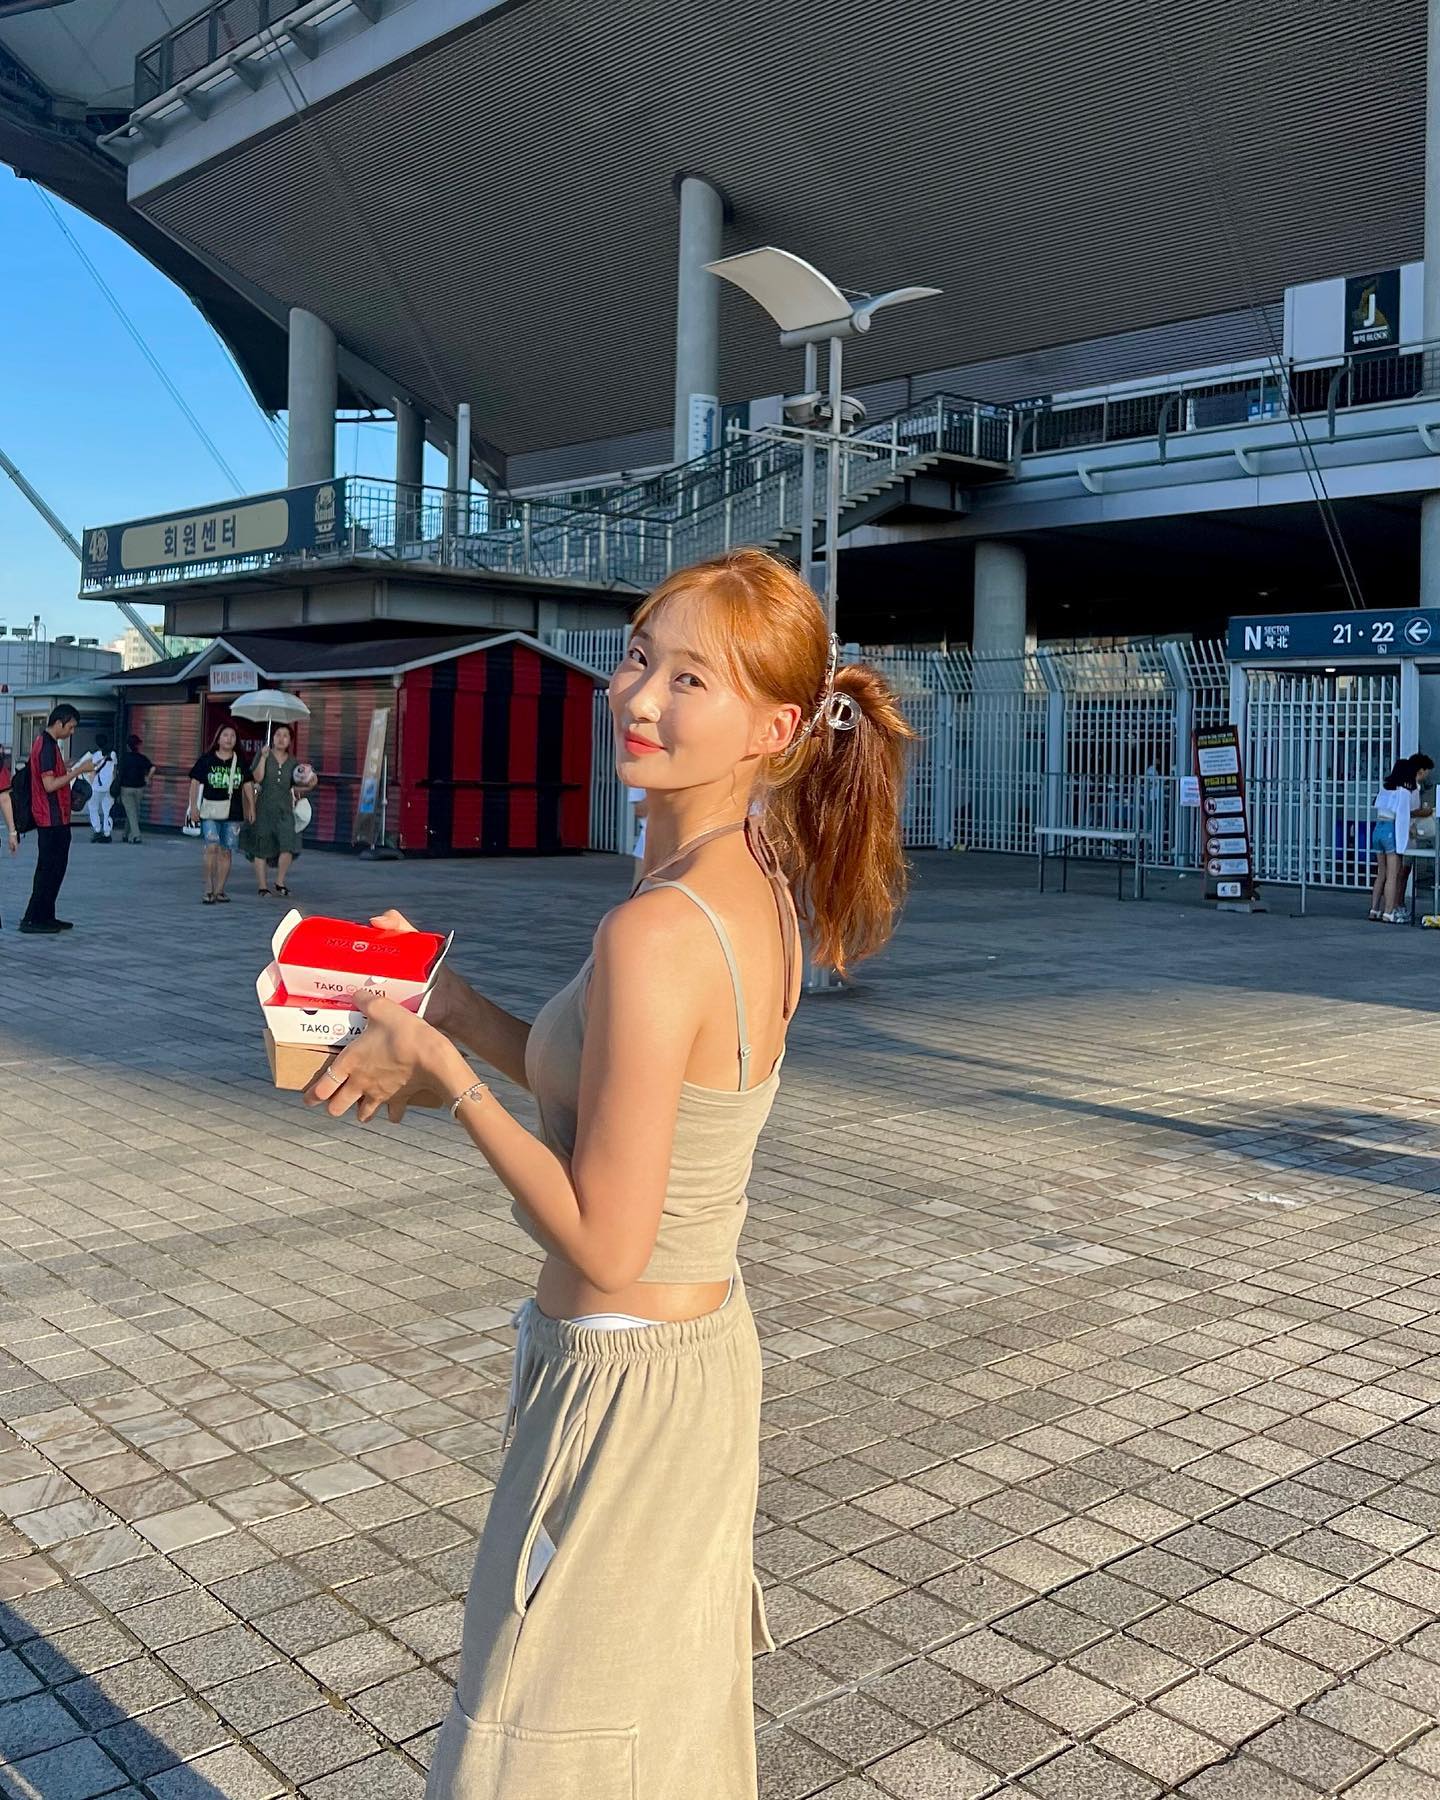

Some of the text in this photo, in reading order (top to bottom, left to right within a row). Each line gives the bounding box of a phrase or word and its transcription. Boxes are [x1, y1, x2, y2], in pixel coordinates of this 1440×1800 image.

[1363, 293, 1376, 327] J
[164, 514, 236, 558] 회원센터
[1244, 625, 1290, 651] N SECTOR
[1332, 623, 1352, 644] 21
[1371, 621, 1395, 643] 22
[314, 981, 343, 992] TAKO
[300, 1023, 330, 1034] TAKO
